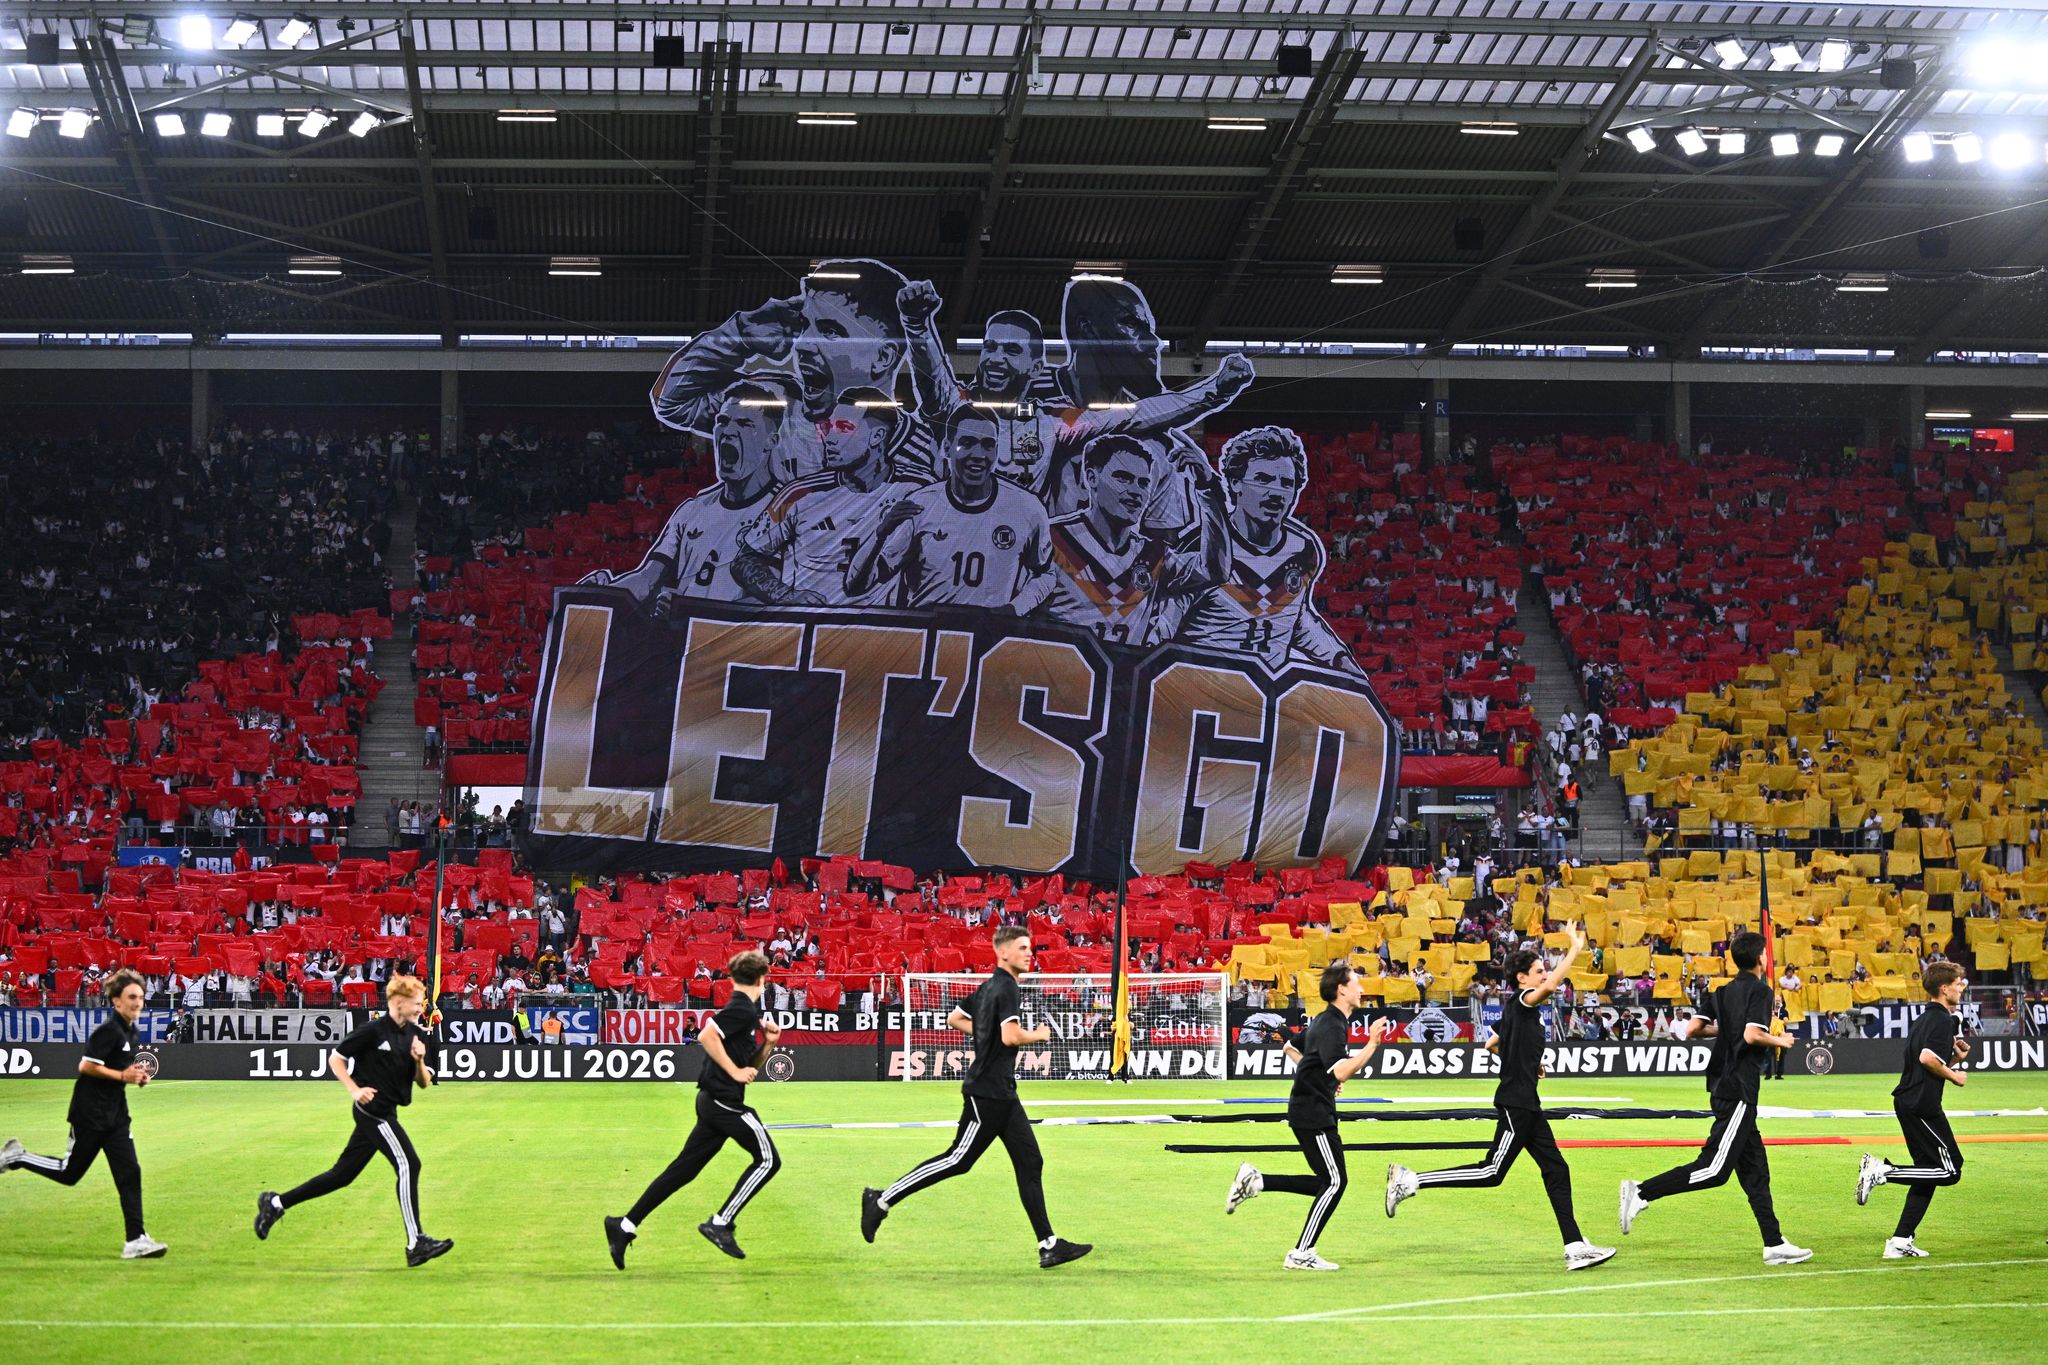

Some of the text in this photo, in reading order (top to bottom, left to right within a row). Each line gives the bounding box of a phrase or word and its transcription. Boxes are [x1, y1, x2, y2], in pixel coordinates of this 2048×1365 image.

[1436, 401, 1446, 415] R
[694, 549, 717, 587] 6
[950, 551, 985, 588] 10
[1239, 617, 1273, 654] 11
[534, 604, 1389, 877] LET'S GO
[199, 1015, 288, 1041] HALLE
[314, 1015, 340, 1041] S.
[535, 1011, 590, 1030] KSC
[761, 1012, 839, 1031] ADLER
[250, 1049, 303, 1077] 11.
[438, 1049, 486, 1078] 19.
[493, 1050, 571, 1078] JULI
[583, 1049, 675, 1079] 2026
[888, 1051, 927, 1077] ES
[1180, 1050, 1223, 1076] DU
[1381, 1048, 1465, 1075] DASS
[1470, 1048, 1502, 1074] ES
[1625, 1046, 1712, 1073] WIRD
[1975, 1040, 2045, 1069] JUN
[1077, 1071, 1115, 1080] bitvav
